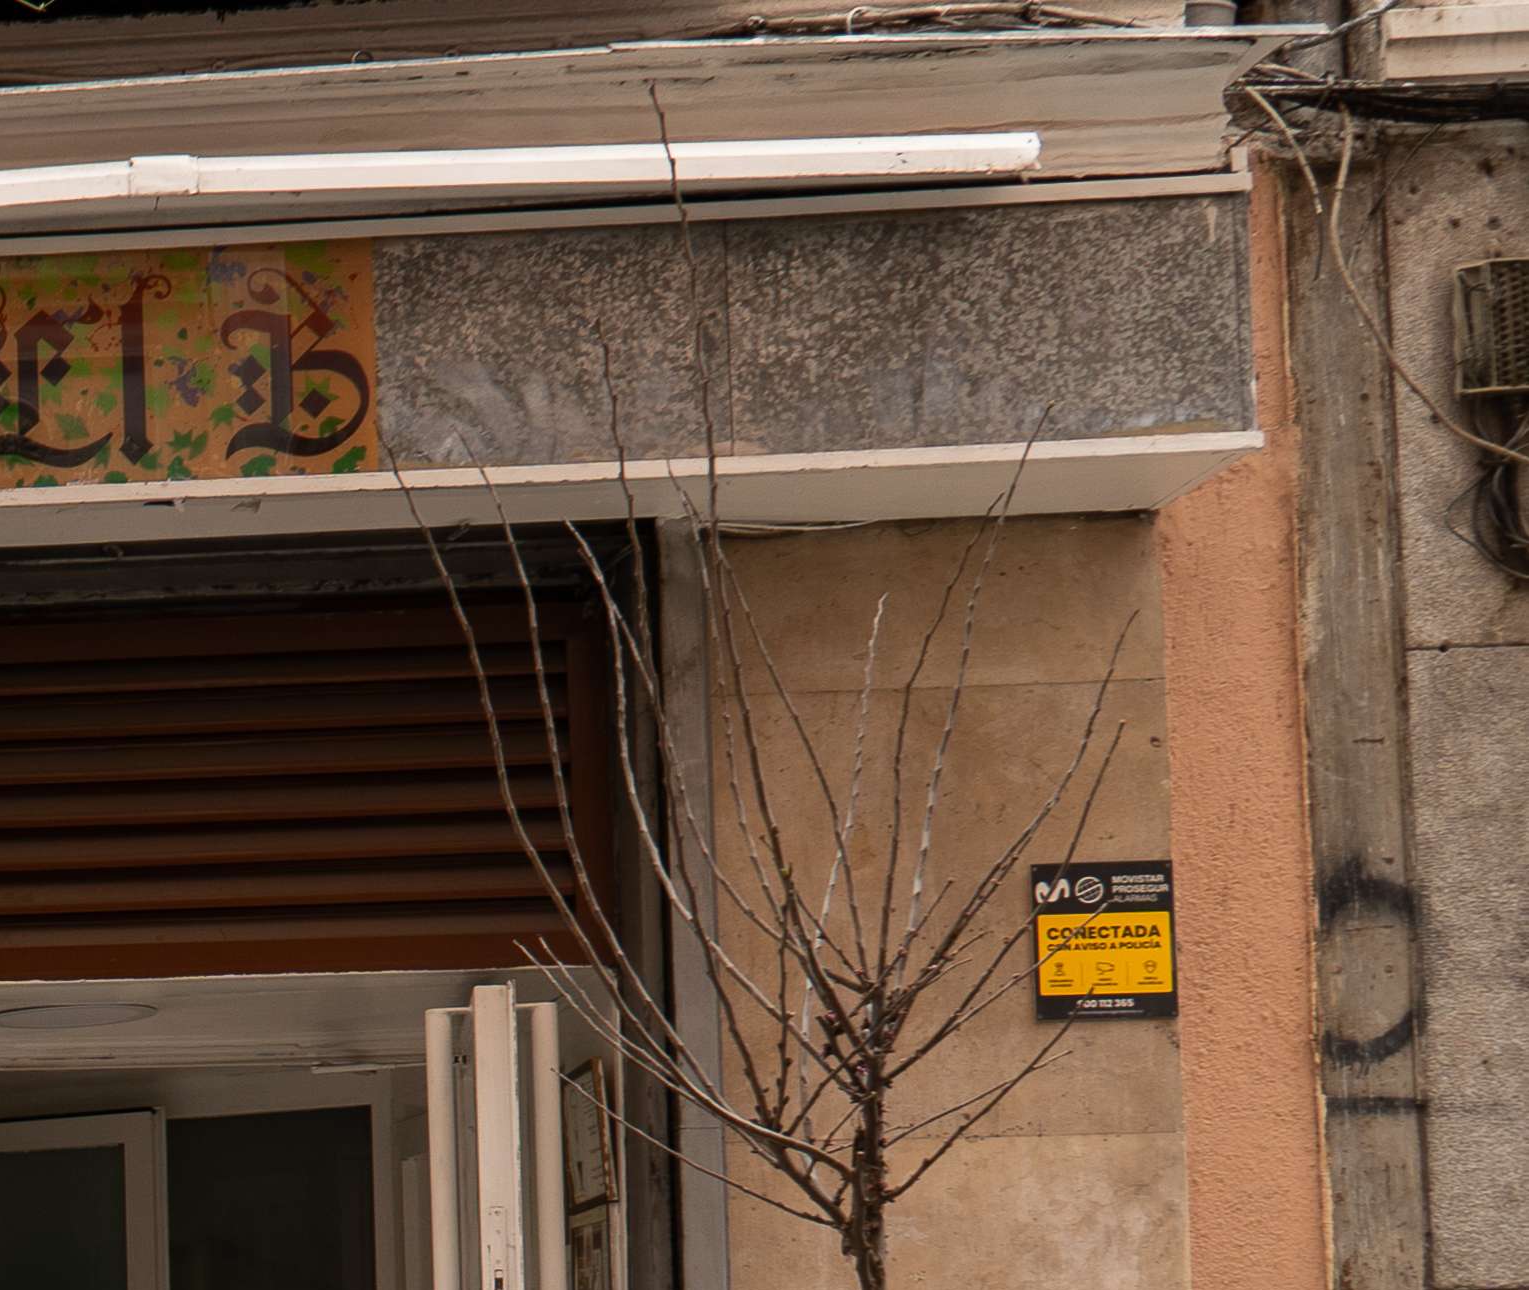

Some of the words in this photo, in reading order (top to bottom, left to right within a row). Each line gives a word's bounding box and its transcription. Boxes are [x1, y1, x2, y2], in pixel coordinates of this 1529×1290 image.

[1111, 874, 1164, 884] MOVISTAR
[1111, 884, 1169, 893] PROSEGUR
[1047, 925, 1161, 940] CONECTADA
[1074, 942, 1107, 950] AVISO
